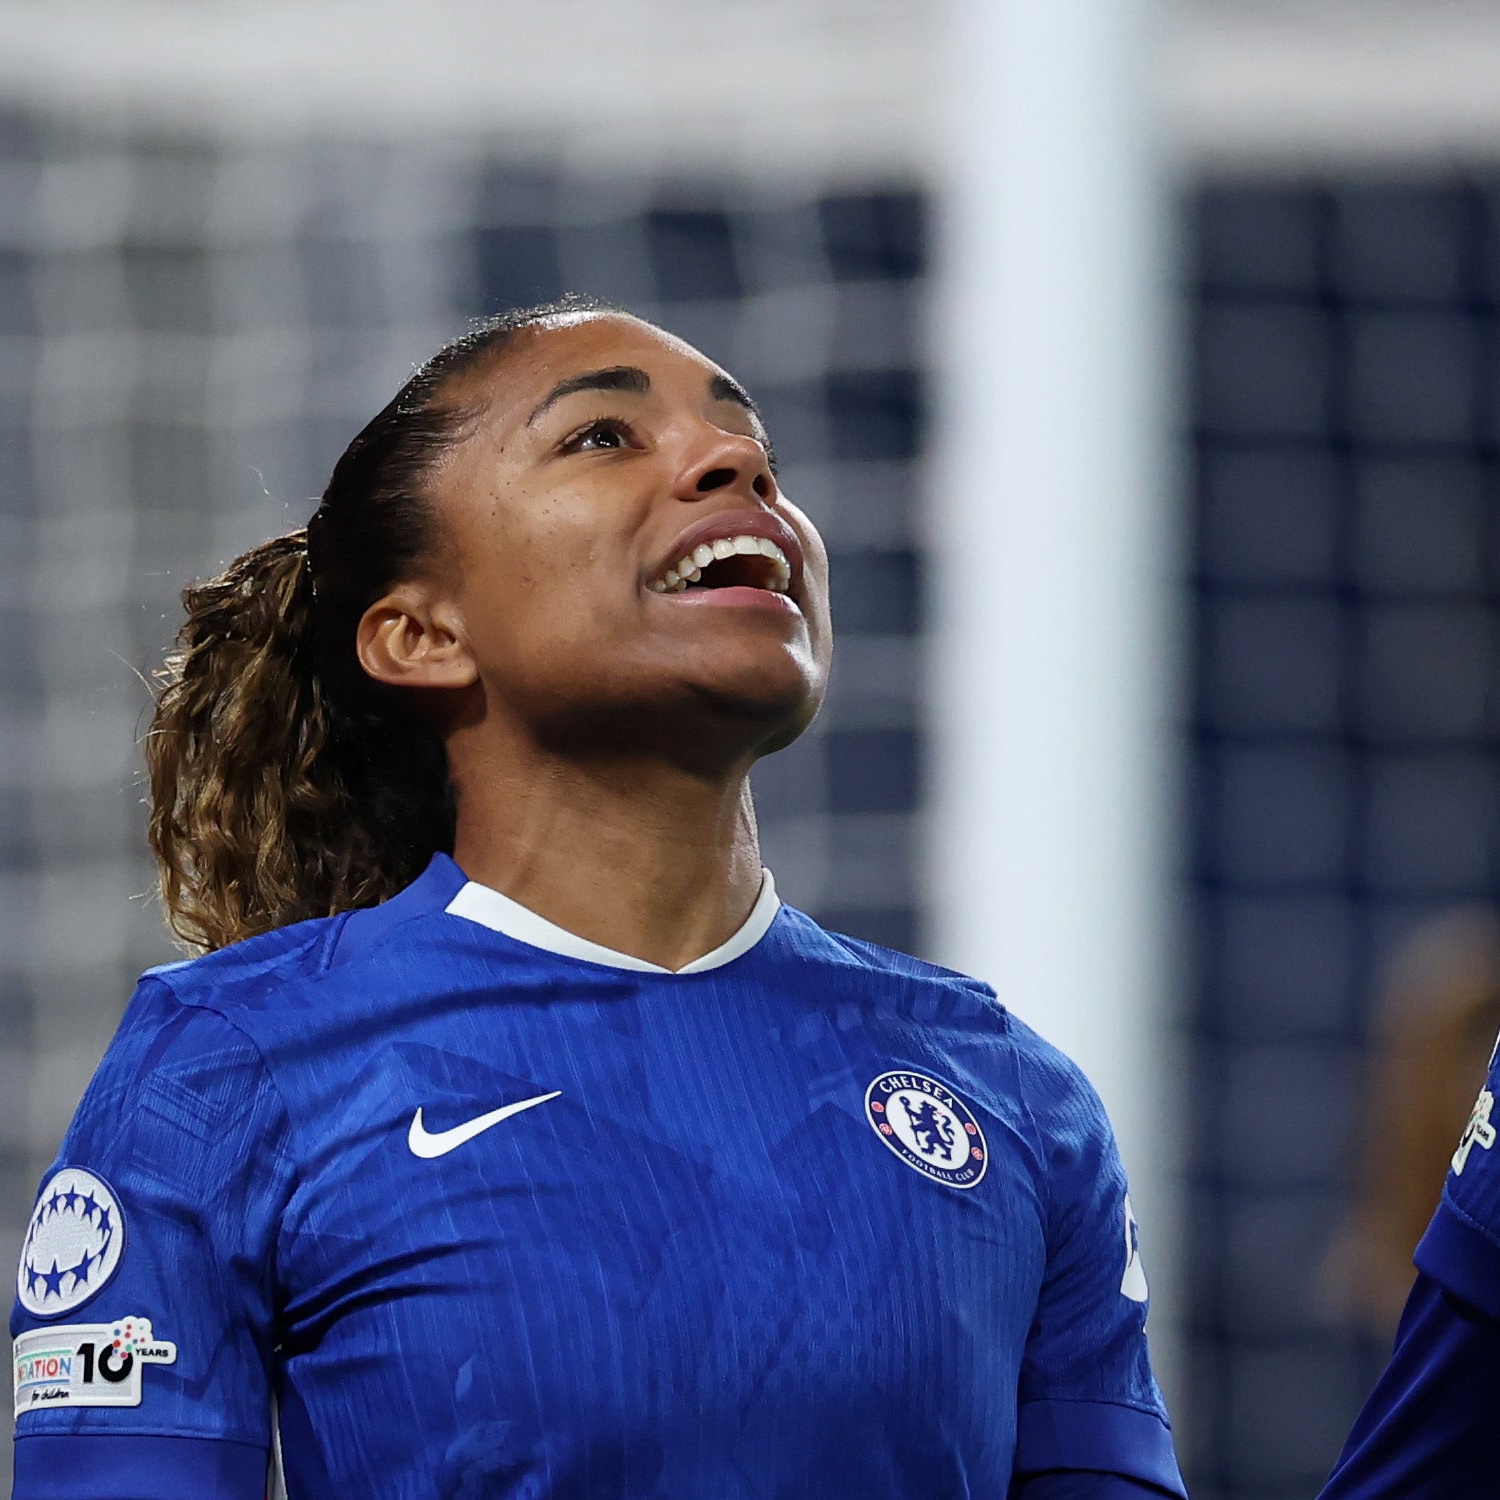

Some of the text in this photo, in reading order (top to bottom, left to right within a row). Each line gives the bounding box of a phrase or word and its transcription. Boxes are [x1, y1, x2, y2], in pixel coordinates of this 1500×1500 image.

[879, 1076, 954, 1108] CHELSEA
[901, 1149, 975, 1182] FOOTBALL CLUB
[76, 1342, 169, 1383] 10 YEARS
